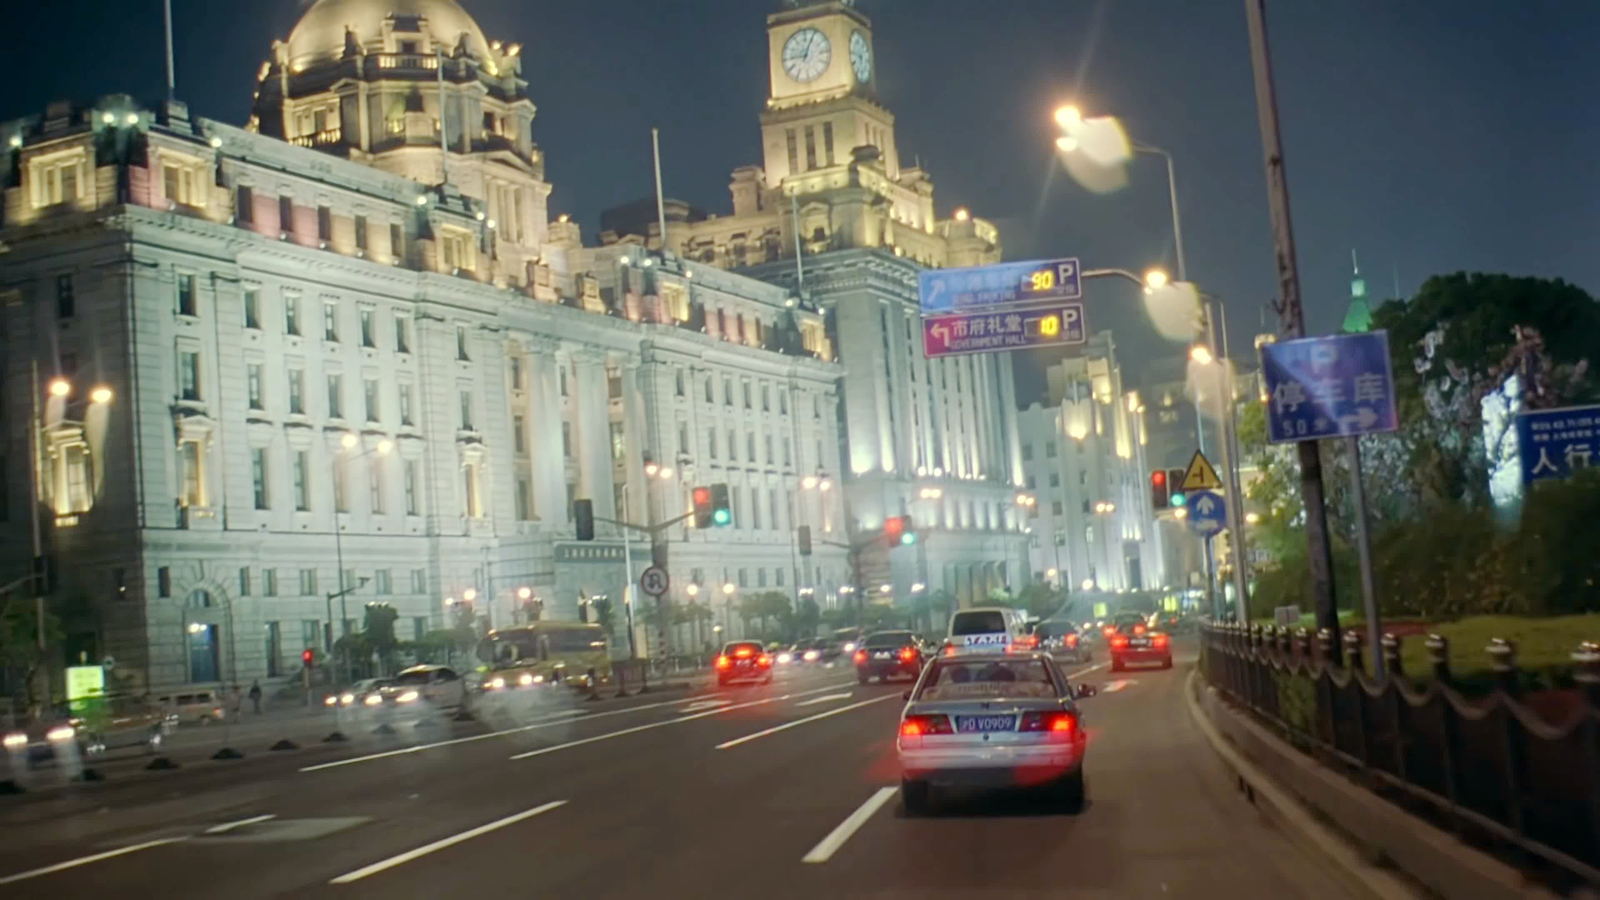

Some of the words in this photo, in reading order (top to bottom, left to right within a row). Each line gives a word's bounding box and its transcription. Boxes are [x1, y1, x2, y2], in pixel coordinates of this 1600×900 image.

[1031, 270, 1054, 290] 90
[1058, 264, 1073, 285] P
[951, 314, 1022, 337] 市府礼堂
[1062, 310, 1078, 330] P
[1530, 443, 1600, 474] 人行
